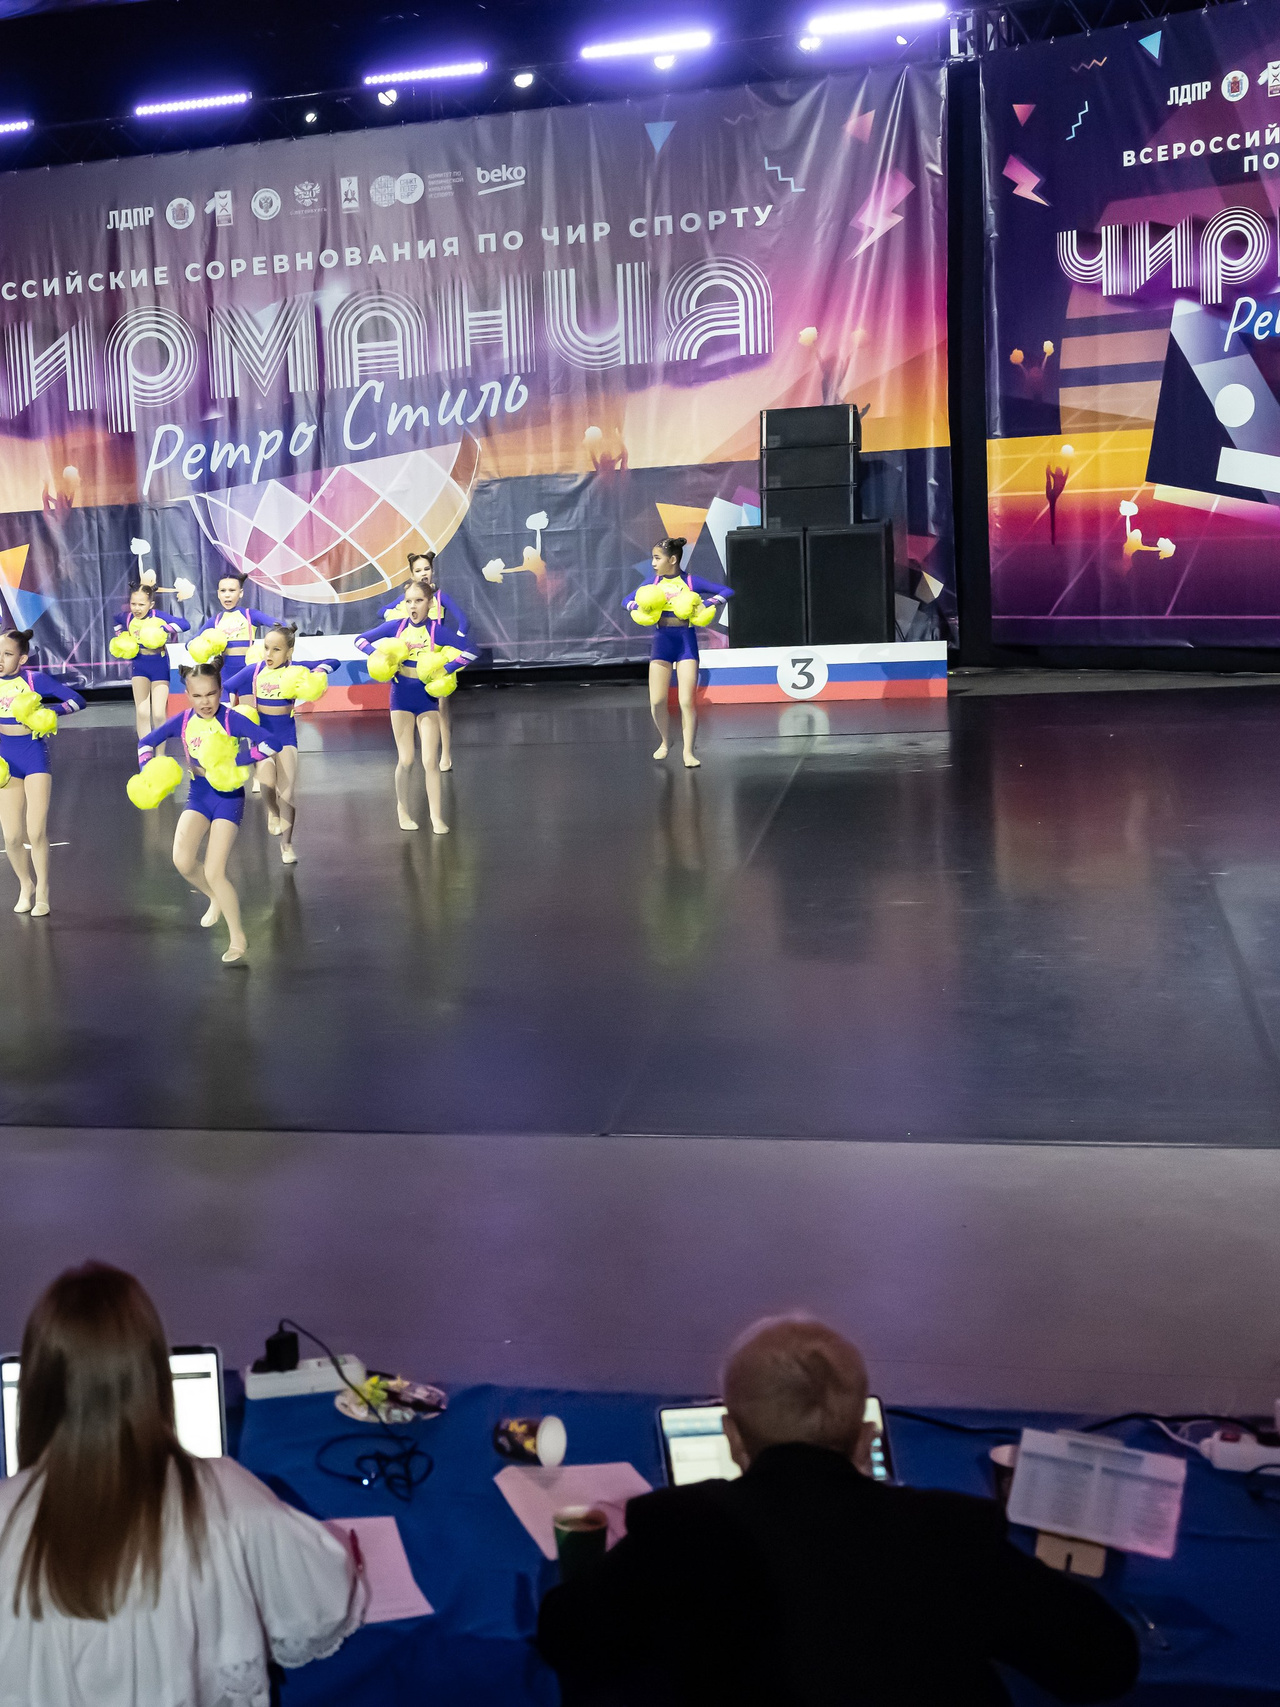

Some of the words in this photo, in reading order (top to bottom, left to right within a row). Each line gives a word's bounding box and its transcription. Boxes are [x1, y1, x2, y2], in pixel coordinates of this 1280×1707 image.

[1167, 81, 1212, 106] ЛДПР
[477, 164, 526, 184] beko
[1244, 151, 1280, 173] ПО
[107, 206, 155, 231] ЛДПР
[184, 238, 460, 282] СОРЕВНОВАНИЯ
[478, 230, 524, 253] ПО
[541, 221, 611, 246] ЧИР
[629, 204, 774, 239] СПОРТУ
[1057, 206, 1280, 305] ЧИР
[1223, 296, 1280, 352] Ре
[142, 423, 318, 495] Ретро
[343, 374, 529, 451] Стиль
[790, 657, 815, 690] 3
